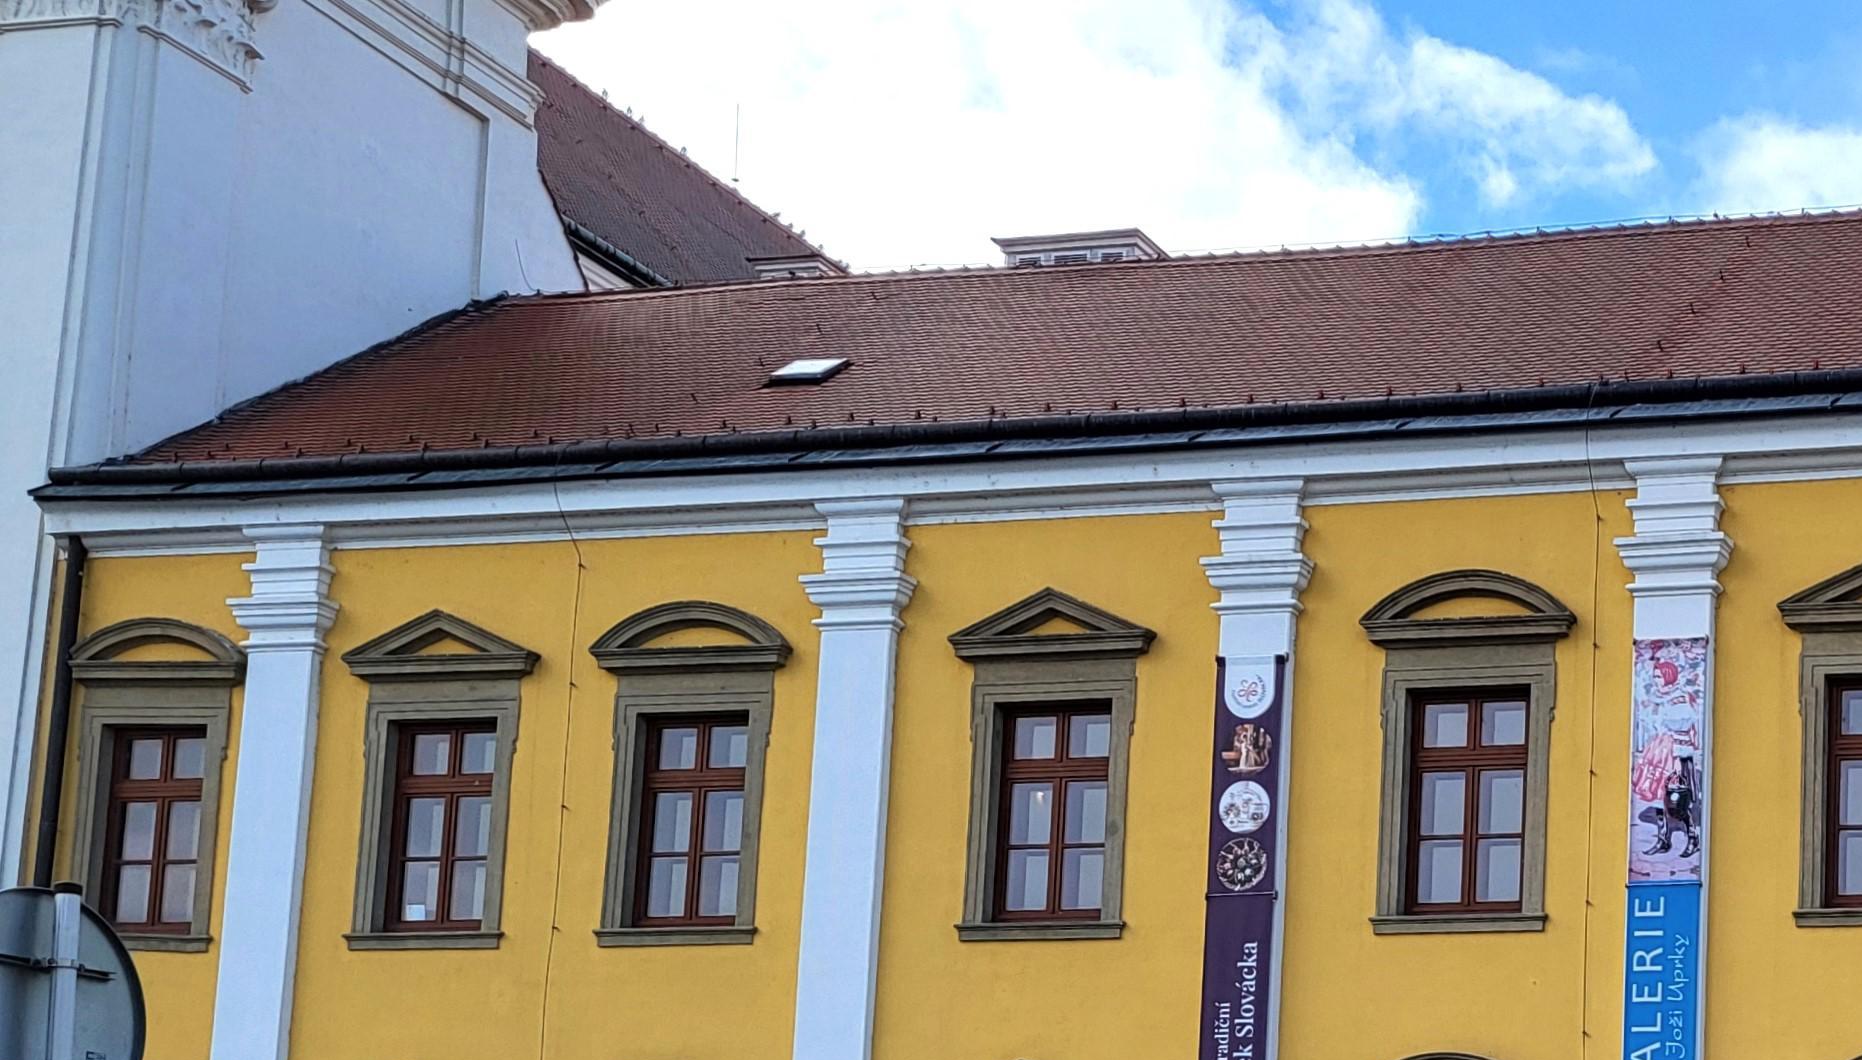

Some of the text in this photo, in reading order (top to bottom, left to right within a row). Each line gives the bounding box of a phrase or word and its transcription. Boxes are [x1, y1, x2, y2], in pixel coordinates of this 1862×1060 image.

[1234, 941, 1258, 1038] Slovácka
[1665, 934, 1690, 1059] Joži Uprky
